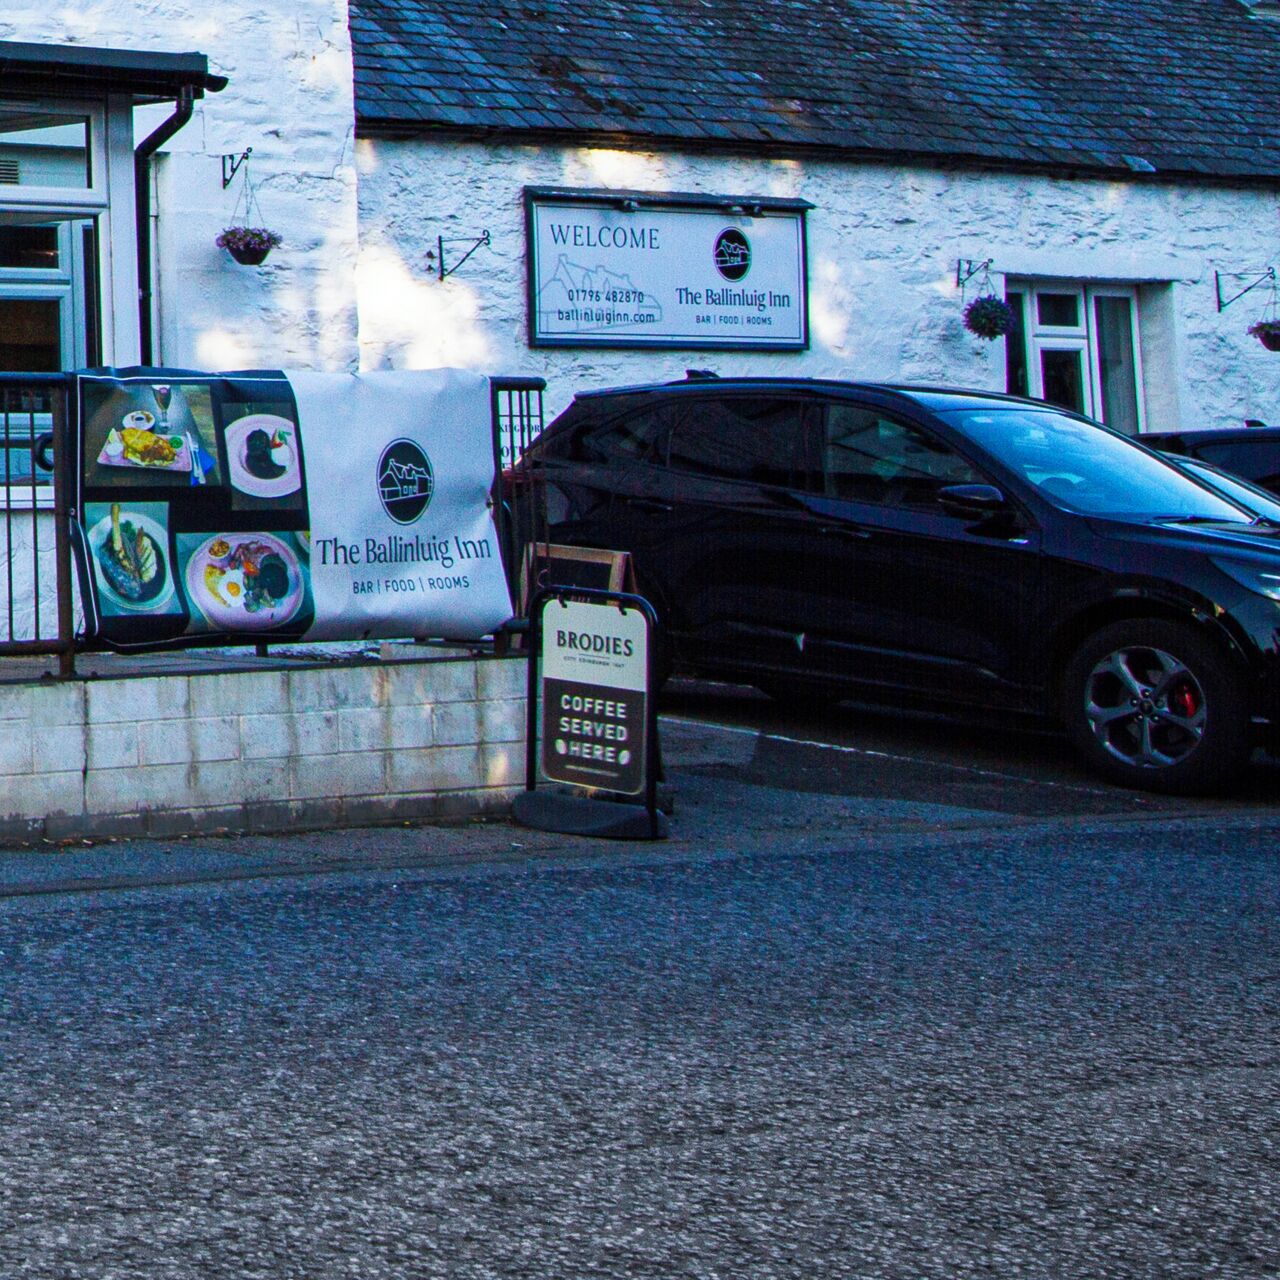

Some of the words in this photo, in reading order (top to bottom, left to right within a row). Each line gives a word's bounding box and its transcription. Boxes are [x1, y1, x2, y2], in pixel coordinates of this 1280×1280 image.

[550, 223, 660, 250] WELCOME
[567, 289, 602, 304] 01796
[605, 289, 645, 304] 482870
[675, 286, 702, 306] The
[705, 288, 766, 312] Ballinluig
[769, 290, 791, 308] Inn
[557, 308, 655, 326] ballinluiginn.com
[695, 314, 711, 324] BAR
[718, 315, 740, 325] FOOD
[746, 316, 773, 326] ROOMS
[316, 538, 361, 565] The
[366, 536, 453, 569] Ballinluig
[456, 537, 491, 559] Inn
[352, 580, 374, 595] BAR
[384, 577, 416, 593] FOOD
[429, 575, 470, 591] ROOMS
[557, 629, 633, 657] BRODIES
[561, 694, 628, 719] COFFEE
[560, 718, 627, 741] SERVED
[568, 741, 616, 763] HERE
